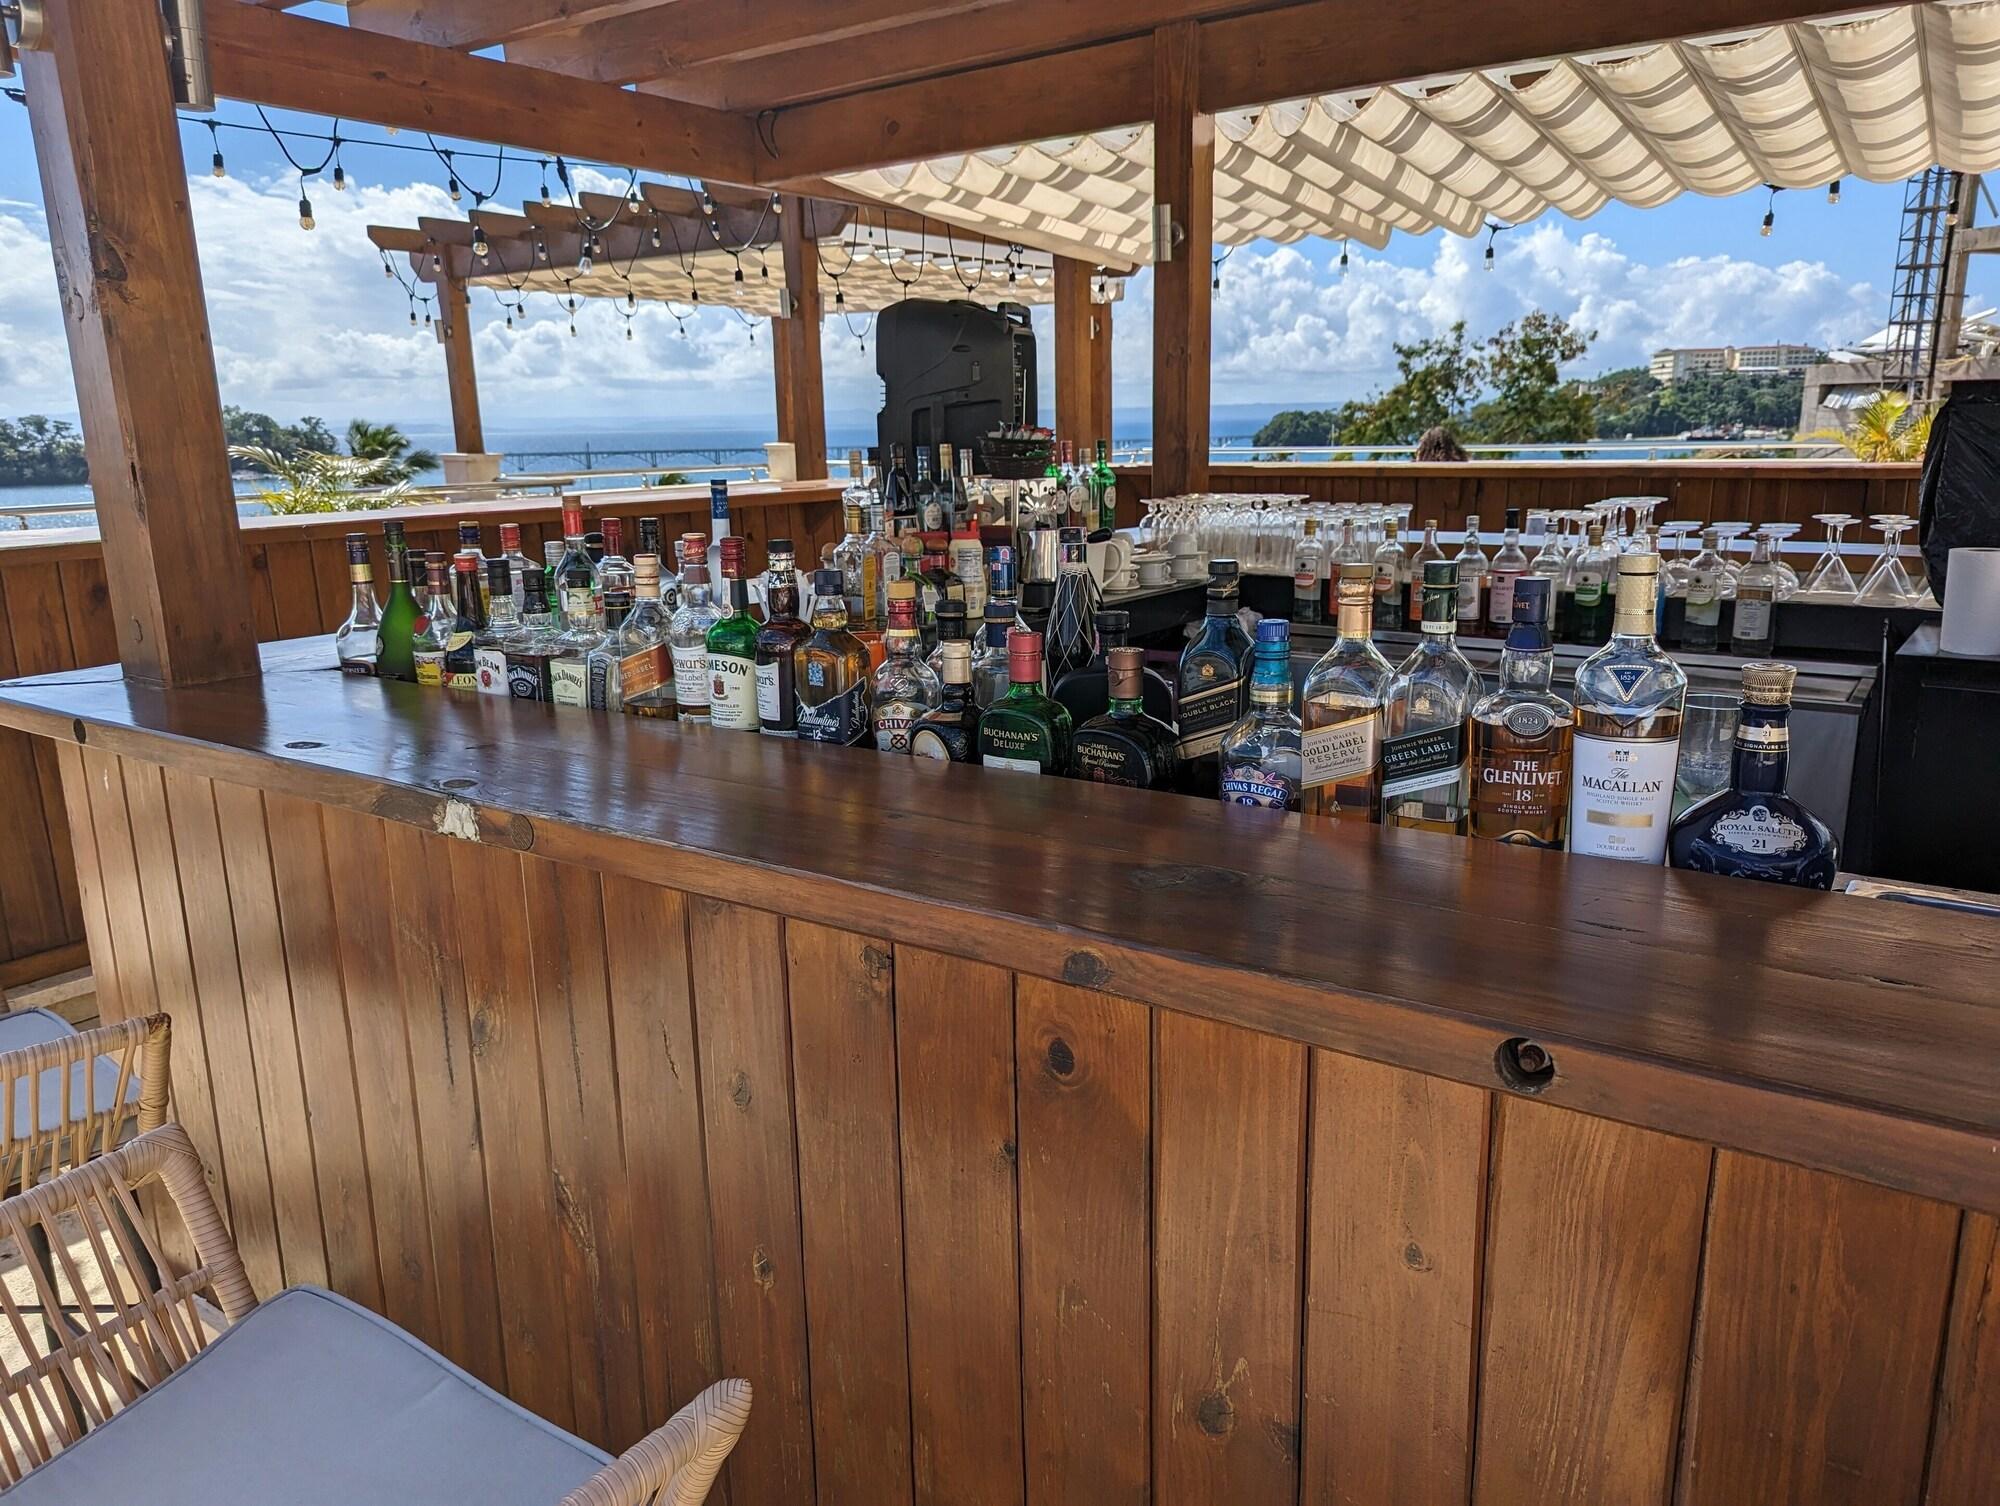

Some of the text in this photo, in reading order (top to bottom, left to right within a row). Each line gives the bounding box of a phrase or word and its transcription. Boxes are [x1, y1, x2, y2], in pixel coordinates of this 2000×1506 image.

[482, 656, 500, 674] BEAM
[672, 656, 706, 669] ewar's
[708, 659, 748, 677] MESON
[517, 667, 539, 686] DANIEL'S
[561, 669, 584, 689] DANIEL'S
[796, 704, 841, 729] Ballantine's
[1179, 698, 1235, 719] OUBLE BLACK
[878, 719, 916, 730] CHIVA
[1518, 716, 1538, 725] 1824
[812, 730, 822, 740] 12
[983, 727, 1039, 742] BUCHANAN'S
[1763, 730, 1772, 738] 21
[1090, 743, 1109, 751] JAMES
[1302, 736, 1367, 758] GOLD LABEL
[1391, 735, 1442, 753] JOHNNIE WALKER
[1077, 744, 1125, 762] BUCHANAN'S
[1308, 746, 1364, 765] RESERVE
[1384, 741, 1454, 764] GREEN LABEL
[1512, 760, 1539, 772] THE
[1608, 767, 1630, 779] The
[1483, 767, 1562, 785] GLENLIVET
[1582, 775, 1661, 793] MACALLAN
[1222, 781, 1285, 800] CHIVAS REGAL
[1515, 789, 1532, 802] 18
[1587, 791, 1616, 800] HIGHLAND
[1720, 823, 1801, 837] ROYAL SALUTE
[1597, 843, 1620, 852] DOUBLE
[1751, 839, 1766, 849] 21
